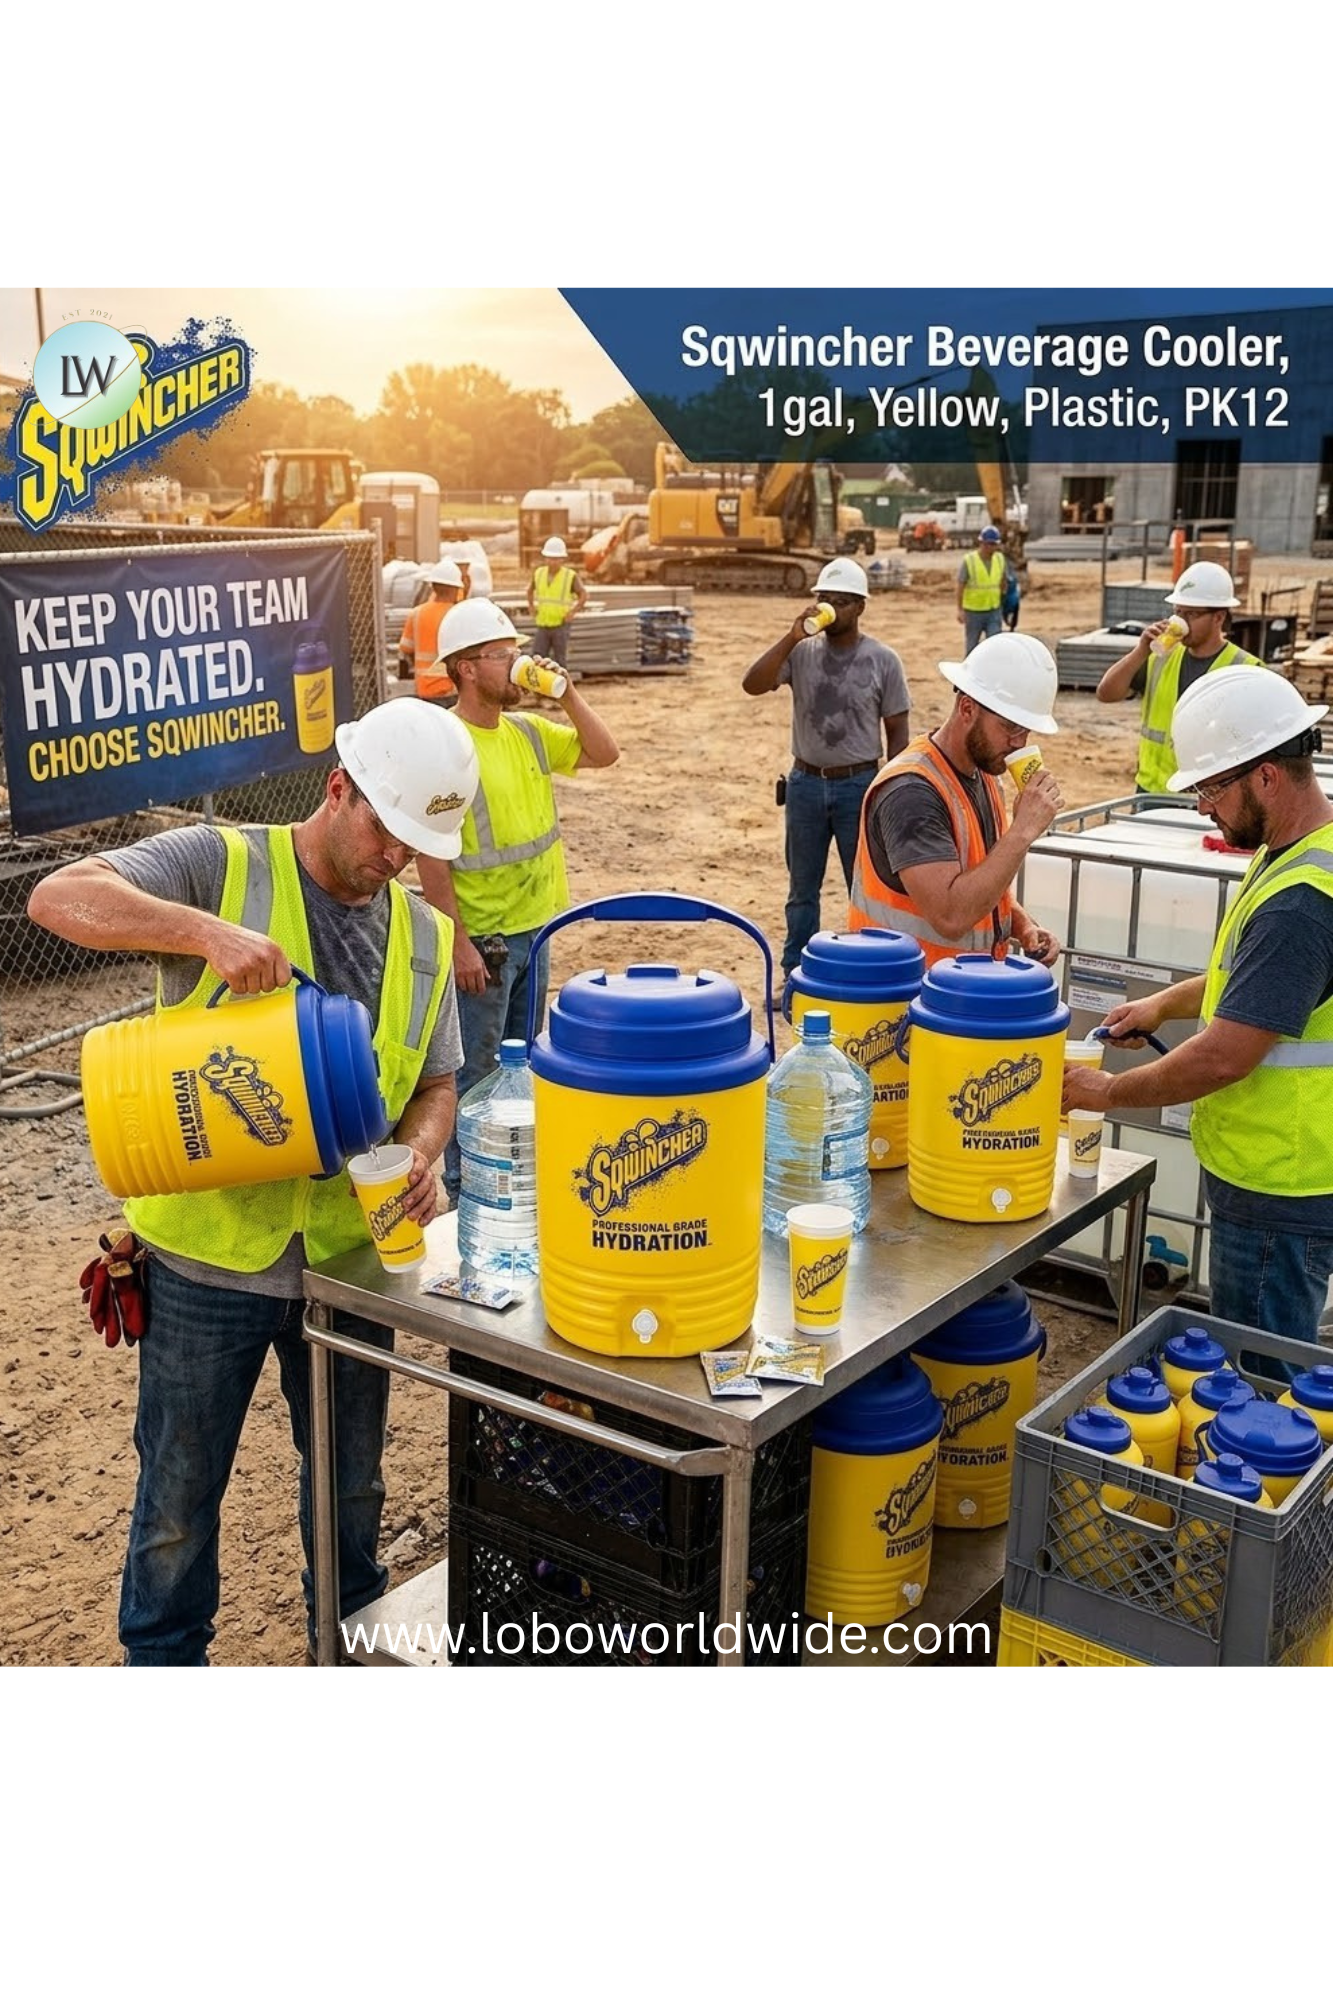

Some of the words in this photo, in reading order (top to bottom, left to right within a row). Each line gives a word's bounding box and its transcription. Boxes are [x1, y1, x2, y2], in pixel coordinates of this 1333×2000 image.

[14, 592, 117, 654] KEEP
[126, 584, 221, 641] YOUR
[226, 576, 309, 630] TEAM
[21, 639, 266, 732] HYDRATED.
[28, 725, 141, 783] CHOOSE
[146, 700, 286, 758] SQWINCHER.
[962, 1135, 1040, 1151] HYDRATION
[592, 1219, 670, 1233] PROFESSIONAL
[592, 1230, 708, 1251] HYDRATION
